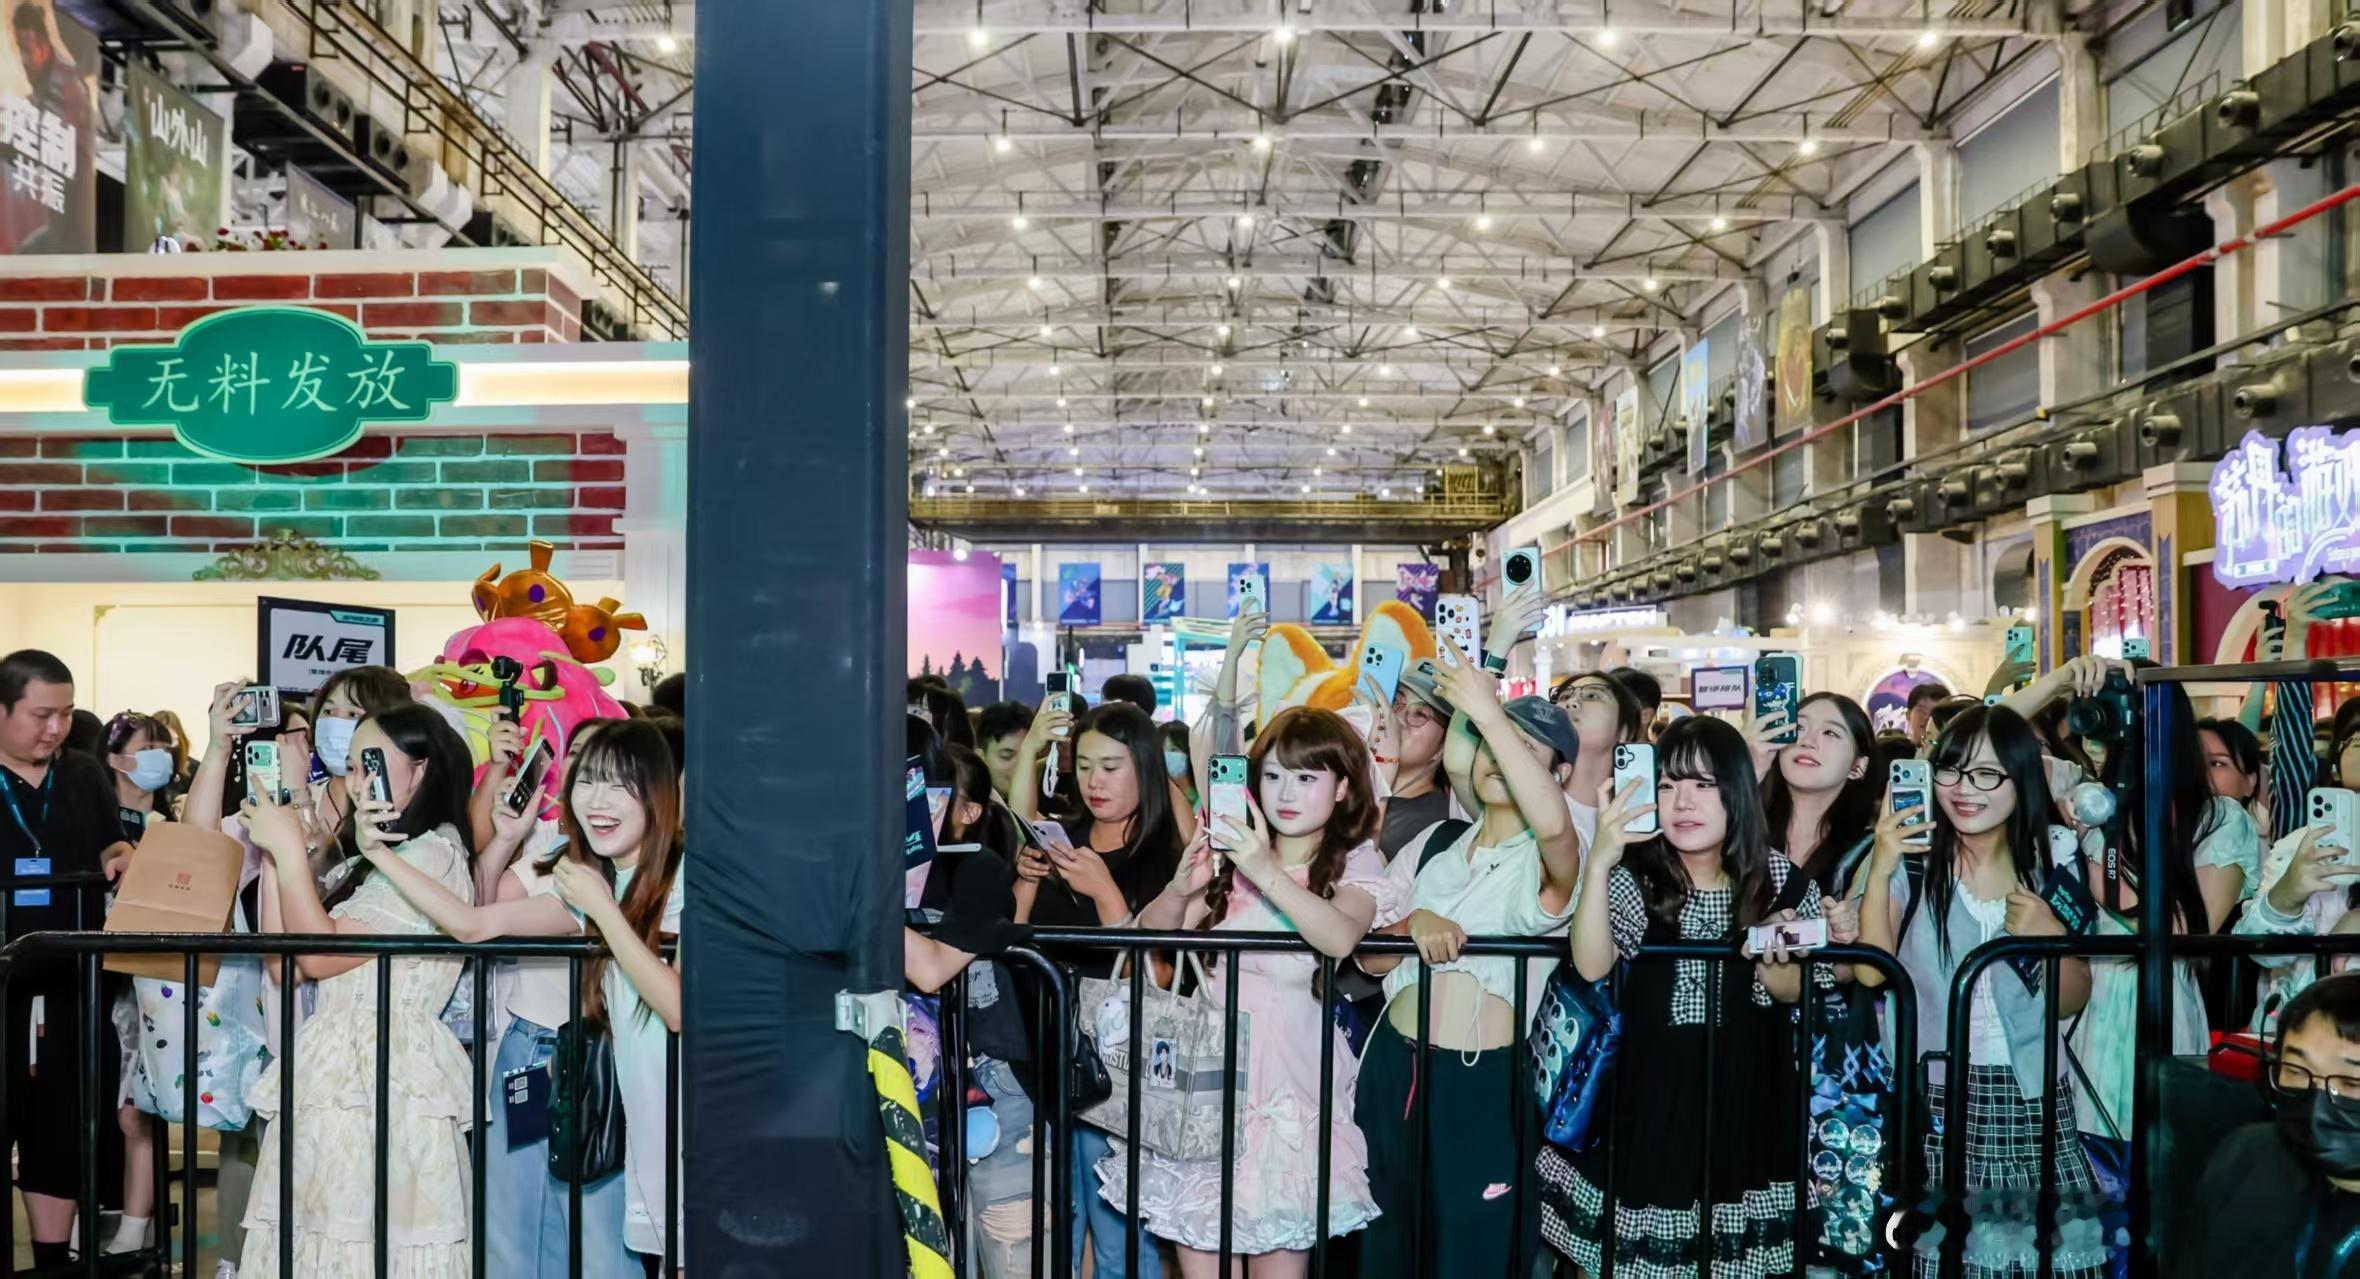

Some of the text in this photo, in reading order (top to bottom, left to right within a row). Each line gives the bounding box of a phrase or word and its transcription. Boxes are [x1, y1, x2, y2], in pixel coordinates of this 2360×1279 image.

[151, 93, 208, 168] 山外山
[13, 154, 66, 214] 共振
[141, 349, 411, 416] 无料发放
[282, 633, 374, 664] 队尾
[2107, 847, 2117, 880] EOS R7
